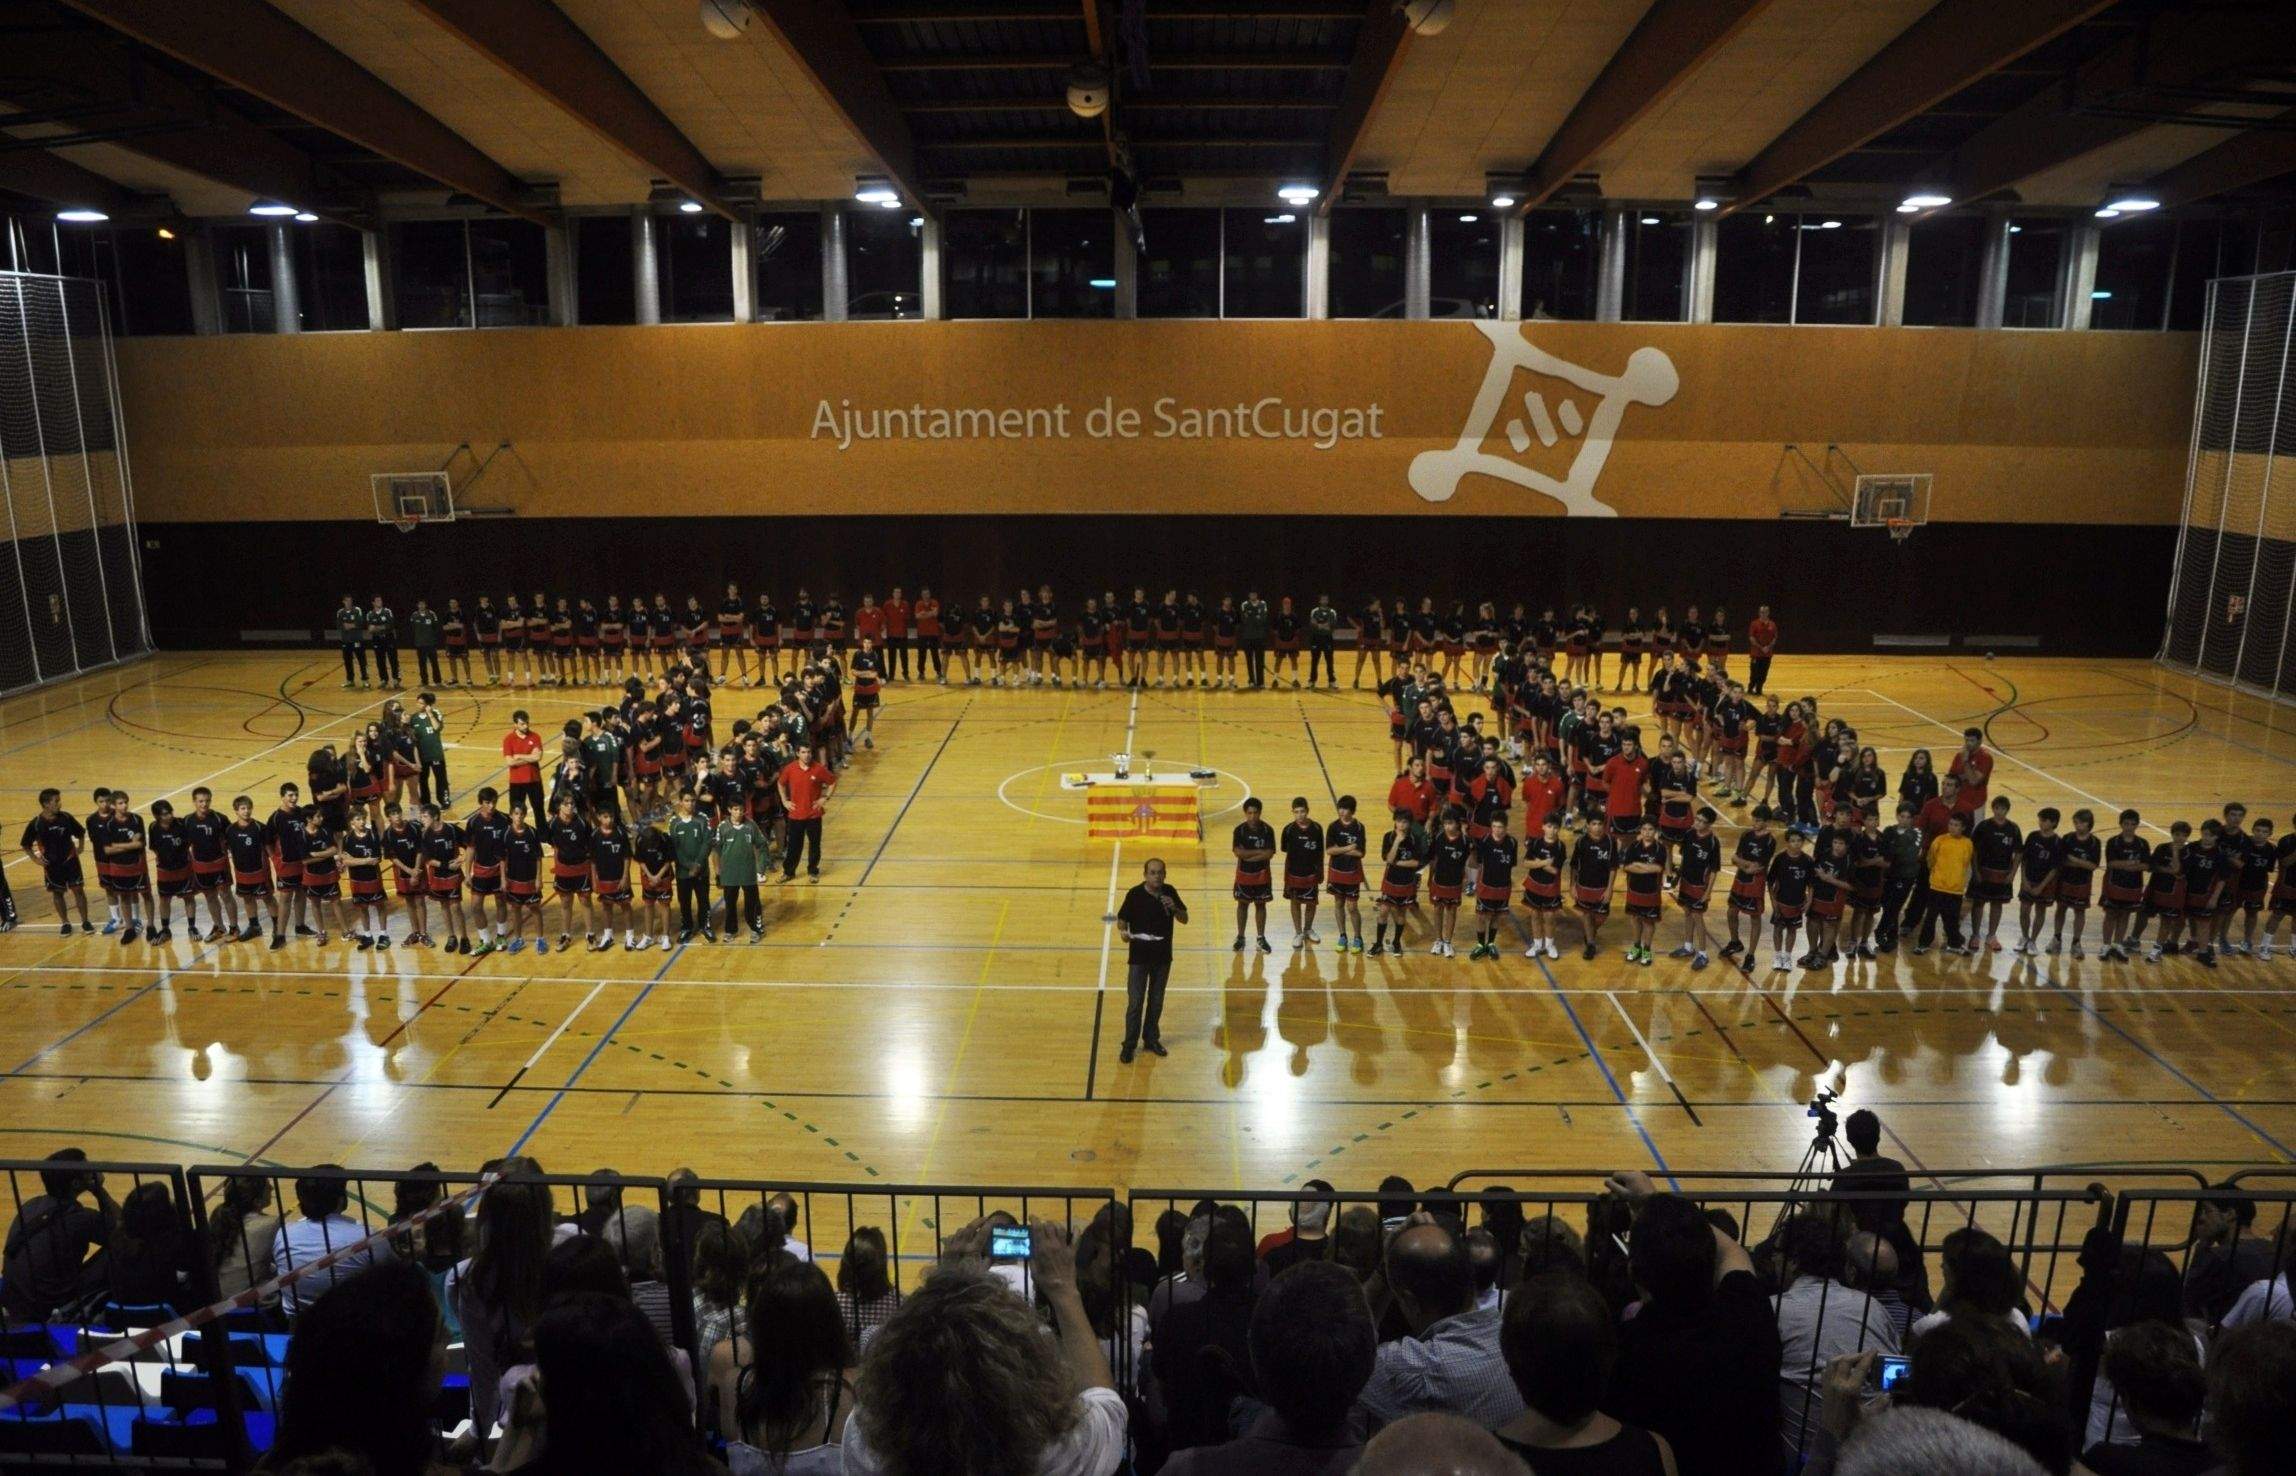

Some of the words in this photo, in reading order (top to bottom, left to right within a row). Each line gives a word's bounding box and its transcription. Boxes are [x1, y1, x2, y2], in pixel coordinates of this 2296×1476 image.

[811, 398, 1071, 451] Ajuntament
[1085, 396, 1141, 438] de
[570, 831, 577, 841] 6
[171, 837, 181, 847] 10
[245, 837, 252, 846] 8
[1304, 841, 1317, 850] 45
[611, 844, 621, 853] 17
